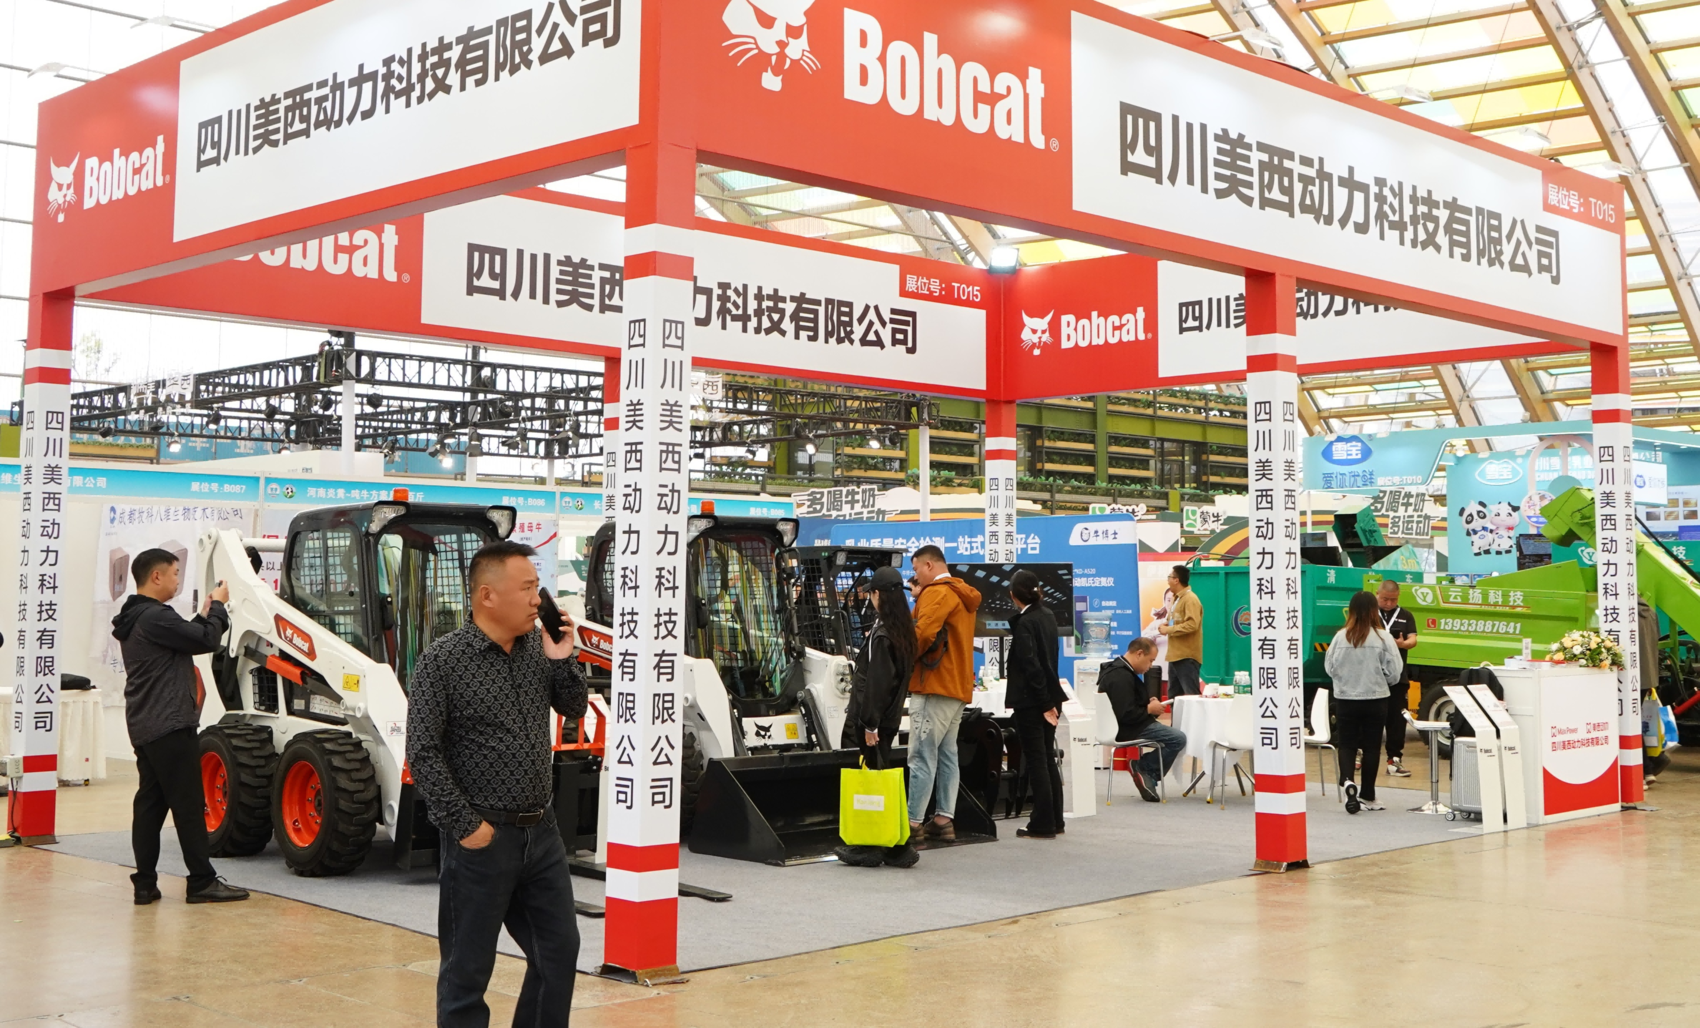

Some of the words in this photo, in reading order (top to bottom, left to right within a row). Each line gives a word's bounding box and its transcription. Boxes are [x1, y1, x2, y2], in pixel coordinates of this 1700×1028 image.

[196, 0, 622, 172] 四川美西动力科技有限公司
[843, 7, 1045, 149] Bobcat
[83, 134, 165, 210] Bobcat
[1119, 101, 1561, 285] 四川美西动力科技有限公司
[233, 224, 398, 282] cat
[466, 243, 917, 354] 四川美西力科技有限公司
[1061, 306, 1146, 349] Bobcat
[1322, 469, 1375, 489] 爱你优鲜
[1332, 441, 1361, 459] 雪宝
[804, 487, 876, 515] 多喝牛奶
[1200, 510, 1223, 530] 蒙牛
[1370, 489, 1427, 514] 多喝牛奶
[1389, 513, 1432, 537] 多运动
[615, 318, 647, 809] 四川美西动力科技有限公司
[650, 318, 685, 809] 四川美西动力科技有限公司
[1092, 529, 1118, 541] 牛博士
[14, 411, 35, 733] 四川美西动力科技有限公司
[33, 411, 64, 733] 四川美西动力科技有限公司
[1254, 401, 1279, 750] 四川美西动力科技有限公司
[1282, 400, 1301, 749] 四川美西动力科技有限公司
[1448, 588, 1524, 606] 云扬科技
[1622, 446, 1639, 716] 四川美西动力科技有限公司
[292, 632, 309, 653] Bobcat
[1440, 618, 1521, 634] 13933887641
